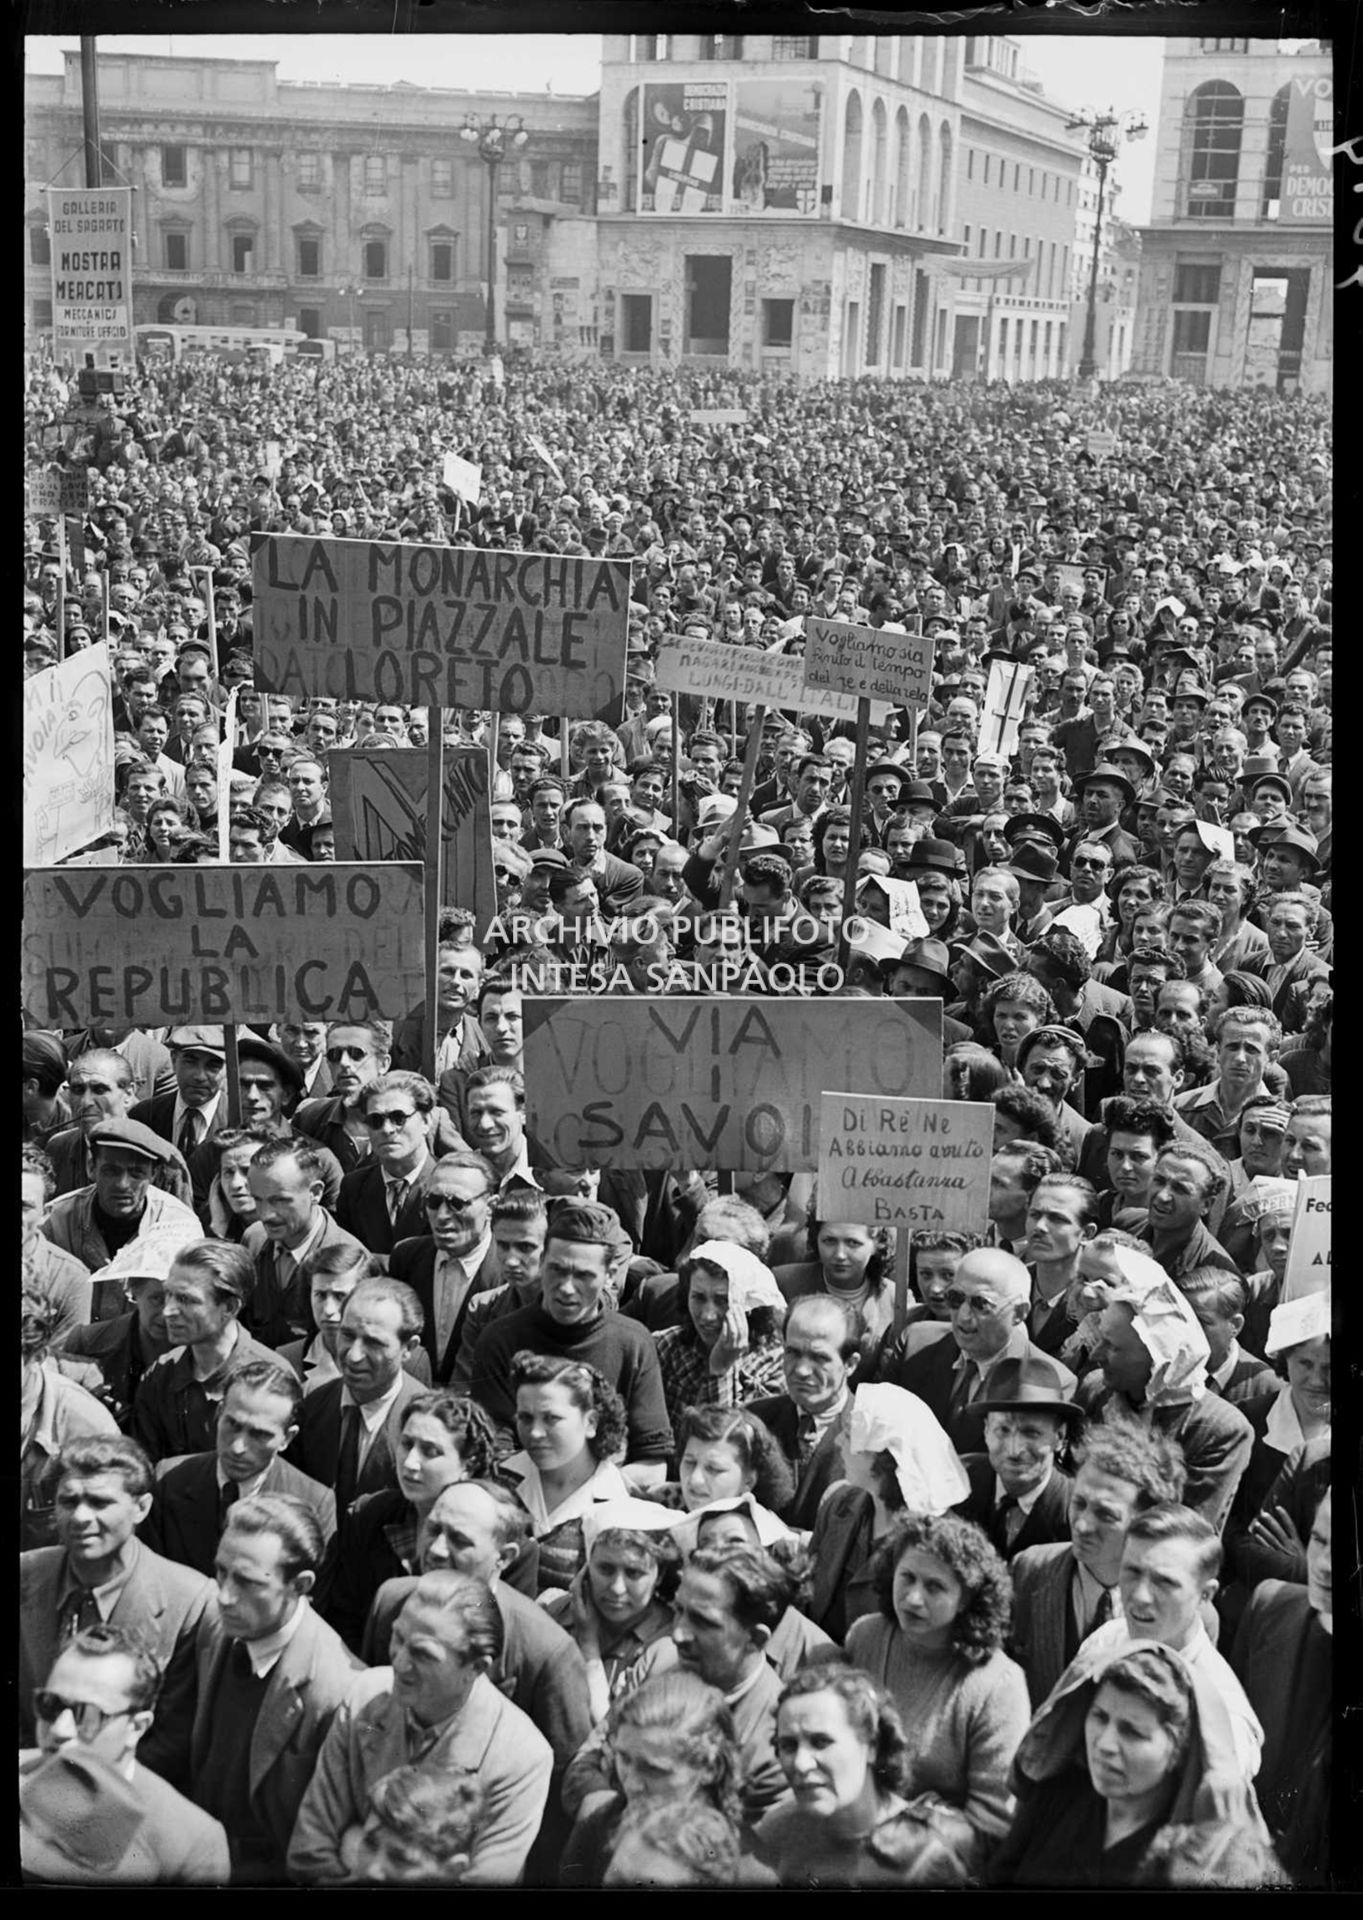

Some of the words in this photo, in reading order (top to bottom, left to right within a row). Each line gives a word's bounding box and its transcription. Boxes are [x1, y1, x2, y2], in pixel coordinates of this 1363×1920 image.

[54, 220, 73, 233] DEL
[63, 201, 116, 215] GALLERIA
[61, 251, 121, 271] MOSTRA
[268, 537, 339, 592] LA
[368, 543, 620, 612] MONARCHIA
[299, 594, 339, 643] IN
[372, 595, 589, 669] PIAZZALE
[815, 627, 898, 658] Vogliamo
[898, 643, 925, 665] sia
[345, 648, 534, 713] LORETO
[809, 669, 831, 683] del
[855, 653, 866, 668] il
[873, 658, 926, 681] tempo
[799, 687, 857, 711] ITALI
[53, 872, 382, 919] VOGLIAMO
[191, 925, 259, 958] LA
[46, 960, 379, 1022] REPUBLICA
[649, 1005, 782, 1058] VIA
[711, 1065, 721, 1103] I
[578, 1101, 812, 1157] SAVOI
[842, 1166, 975, 1190] Abbastanza
